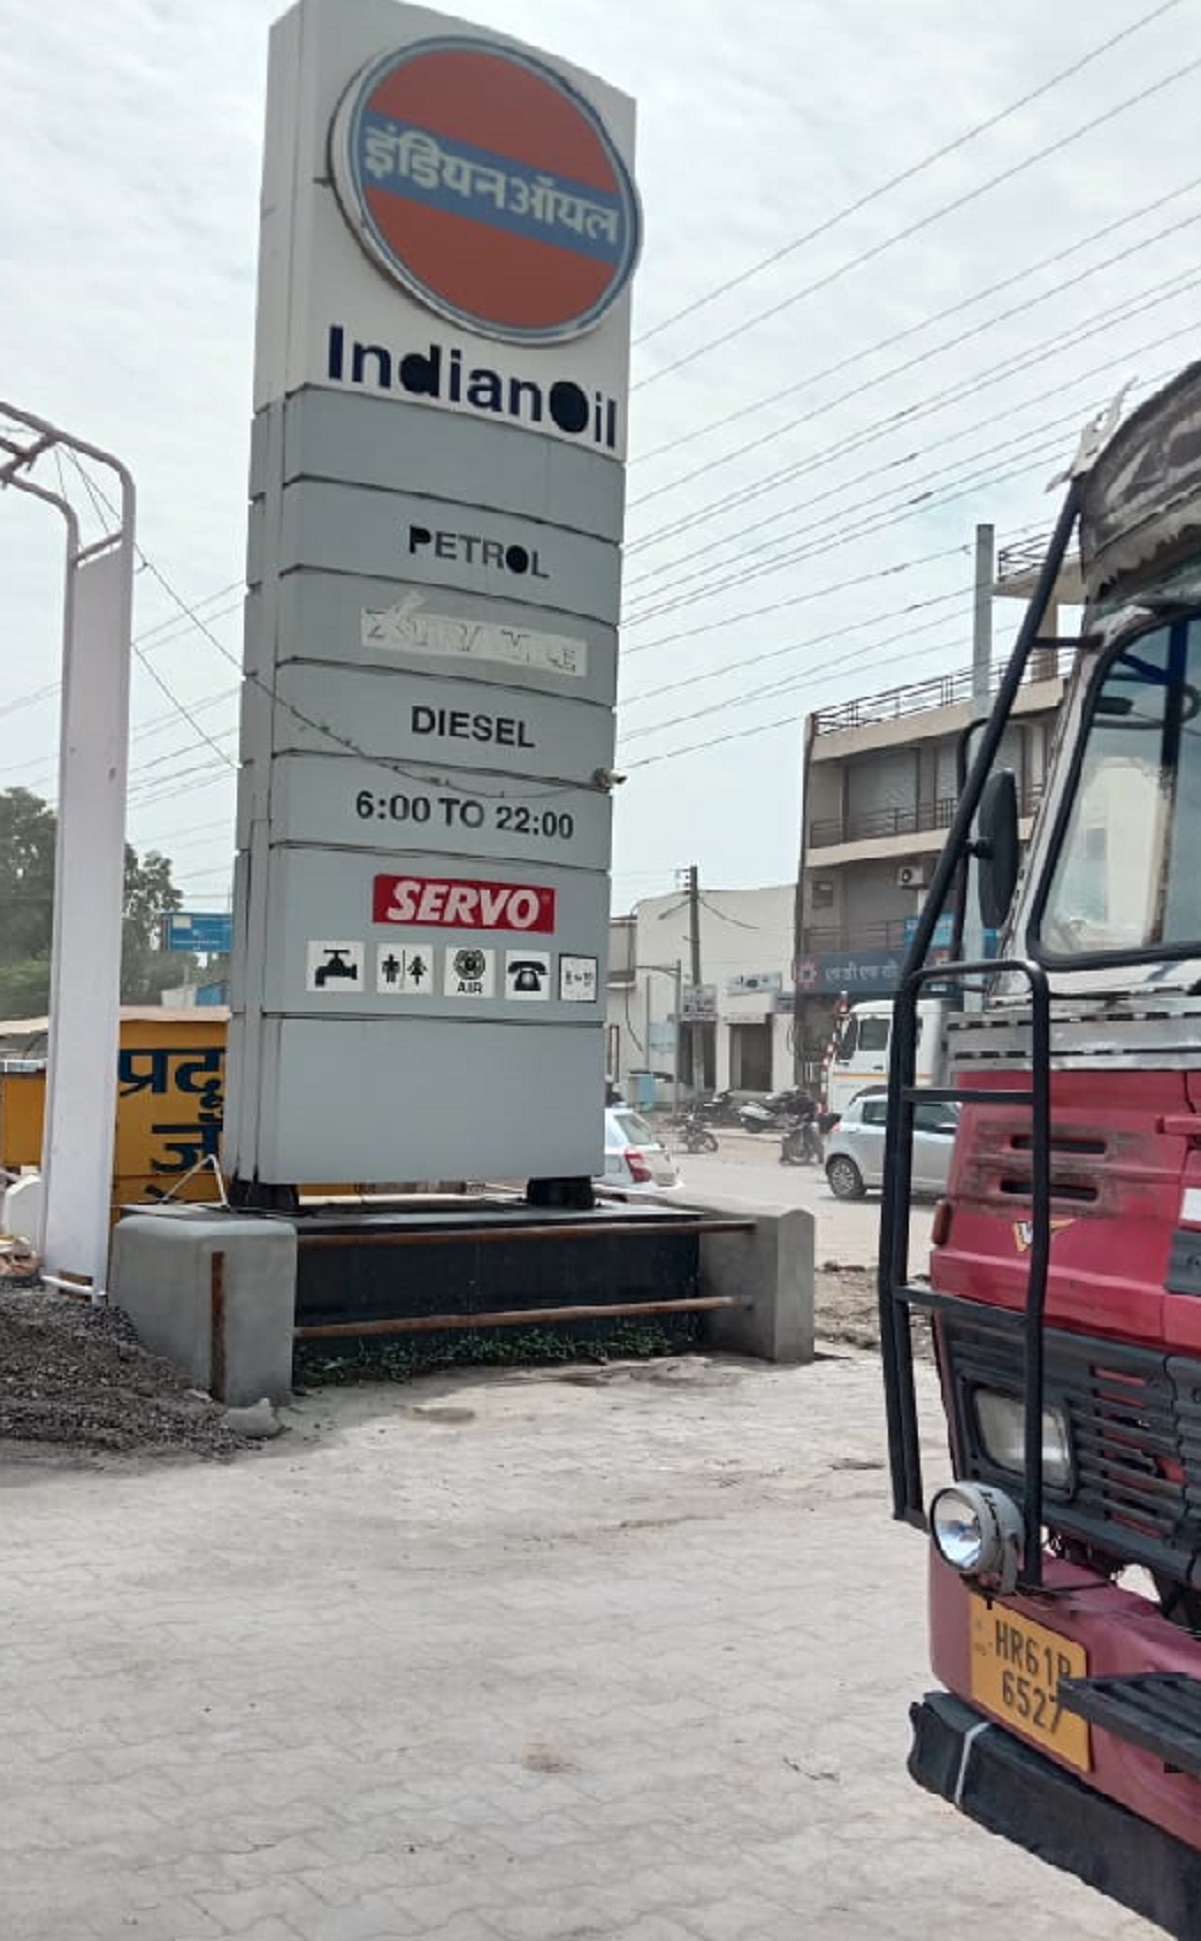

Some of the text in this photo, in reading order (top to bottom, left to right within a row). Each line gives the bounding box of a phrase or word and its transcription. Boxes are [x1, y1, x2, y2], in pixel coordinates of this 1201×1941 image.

[329, 325, 616, 448] IndianOil
[409, 525, 550, 579] PETROL
[411, 706, 536, 748] DIESEL
[356, 790, 574, 839] 6:00 TO 22:00
[387, 880, 540, 929] SERVO
[457, 981, 484, 994] AIR
